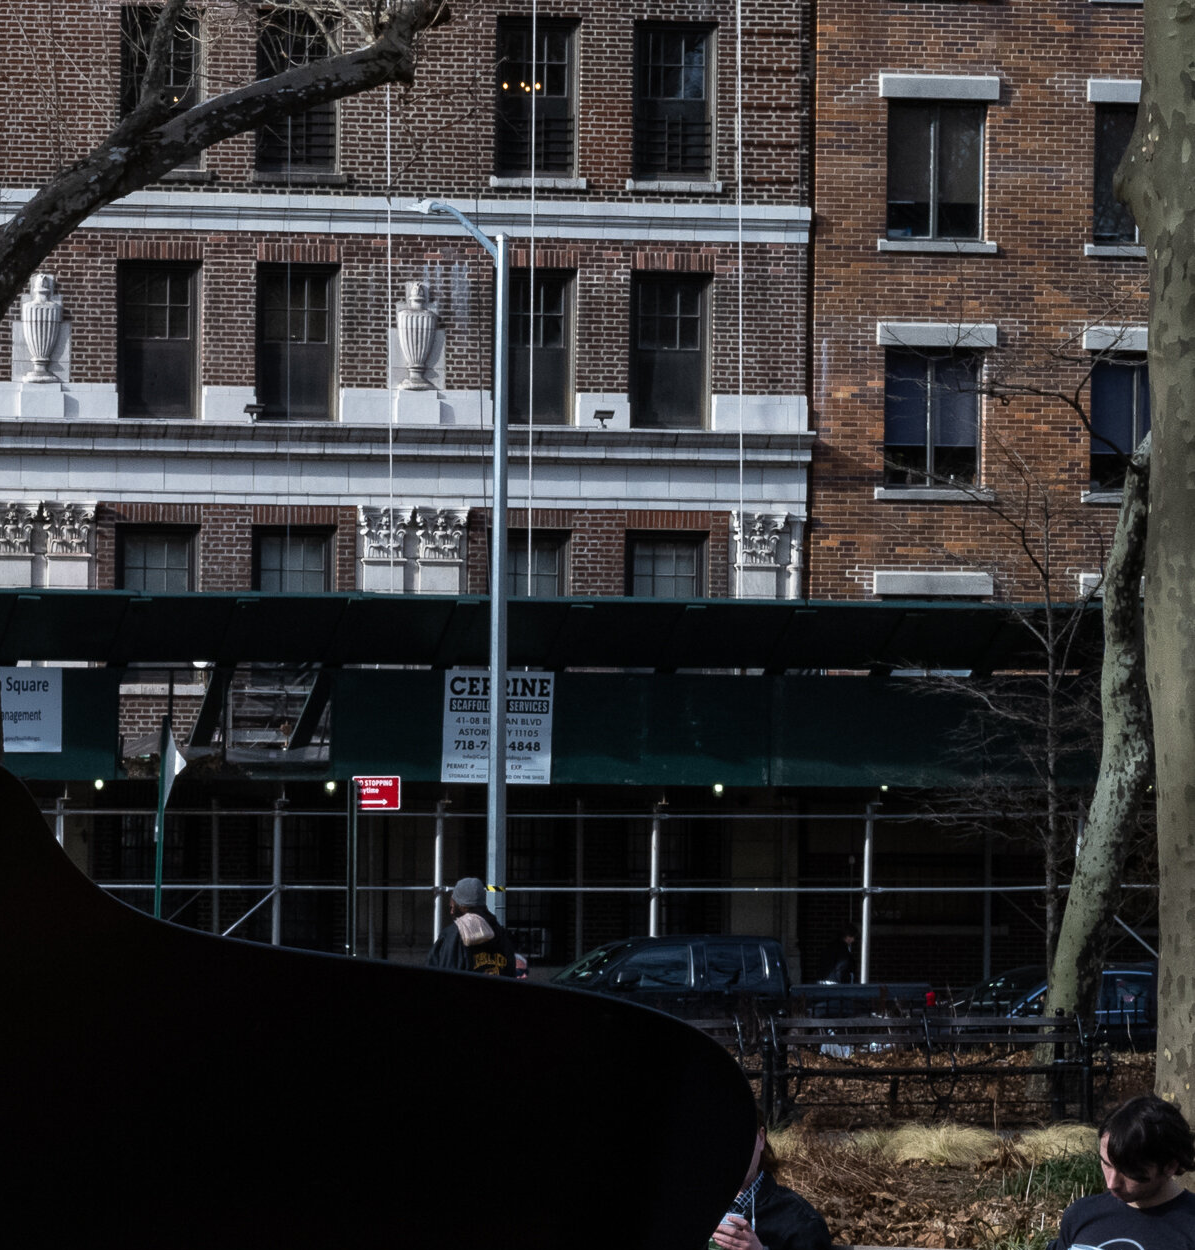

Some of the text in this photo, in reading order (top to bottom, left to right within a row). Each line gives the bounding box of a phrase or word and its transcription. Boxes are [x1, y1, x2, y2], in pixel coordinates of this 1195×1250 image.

[6, 676, 49, 695] Square
[451, 699, 548, 713] SCAFFOL SERVICES
[0, 709, 42, 724] anagement
[520, 718, 542, 726] BLVD
[458, 728, 490, 737] ASTORI
[364, 779, 393, 787] STOPPING
